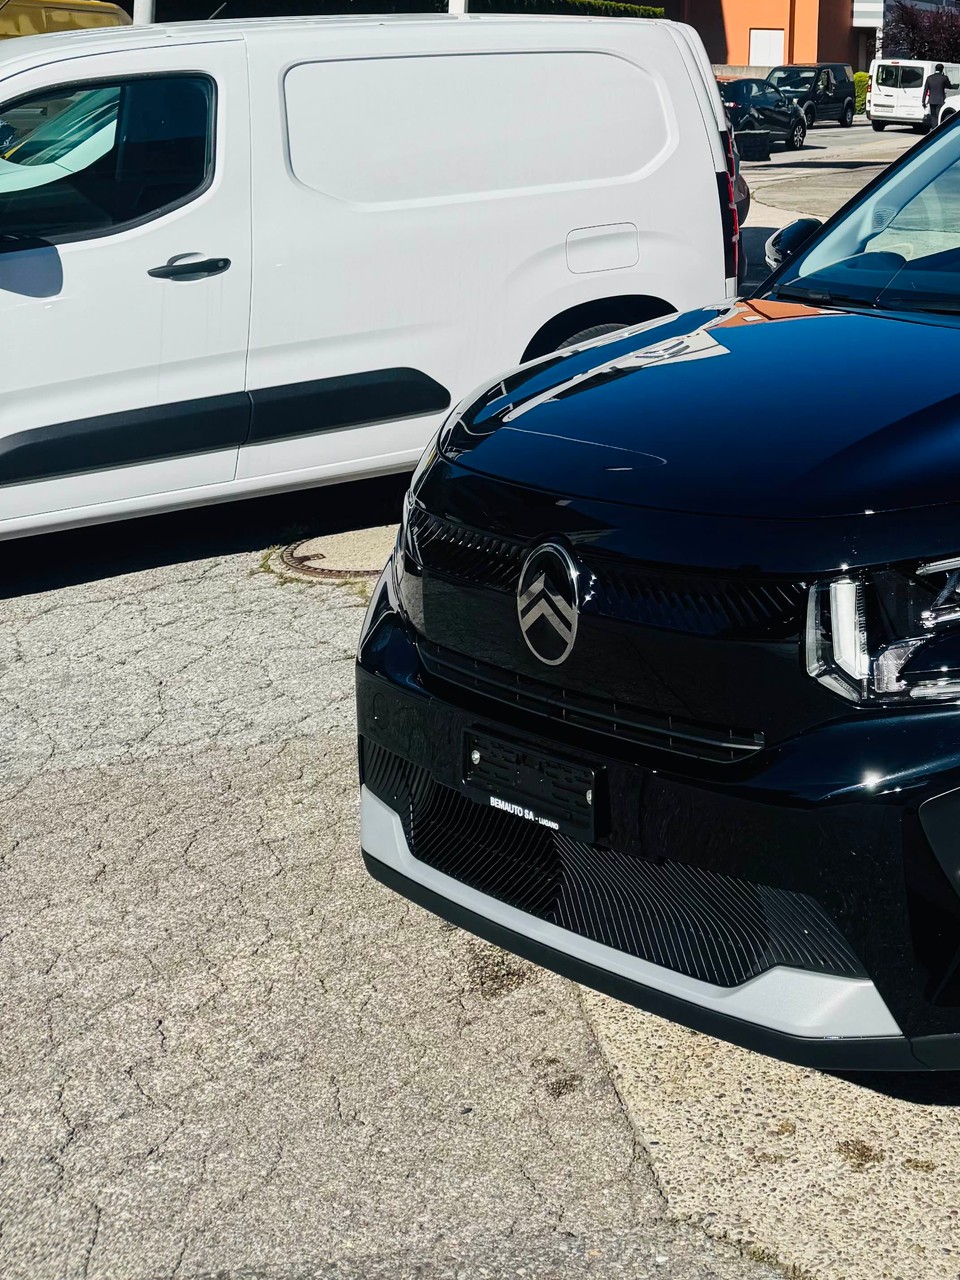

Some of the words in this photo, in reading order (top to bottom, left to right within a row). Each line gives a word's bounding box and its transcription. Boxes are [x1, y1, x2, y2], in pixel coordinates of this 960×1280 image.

[490, 796, 523, 817] BEMAUTO
[524, 809, 535, 821] SA
[538, 817, 559, 830] LUGANO
